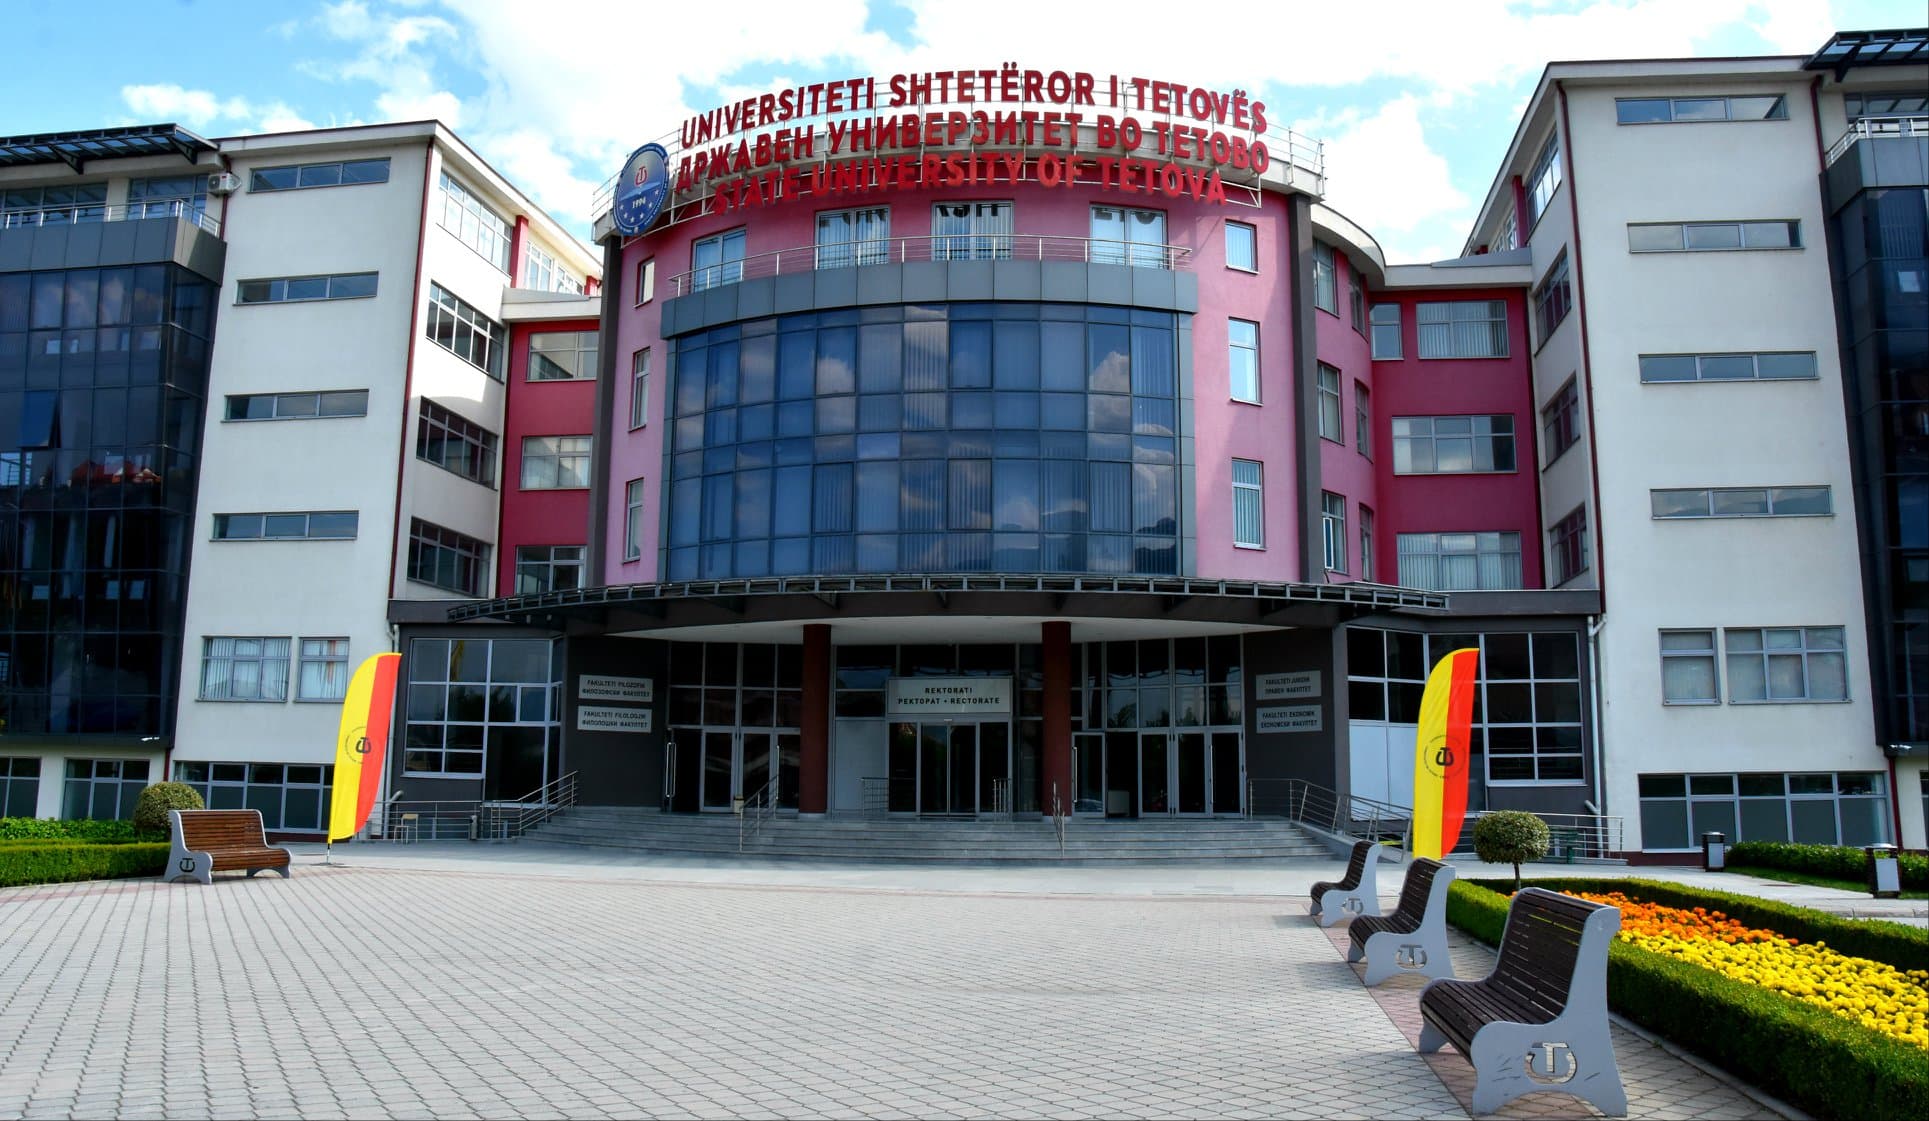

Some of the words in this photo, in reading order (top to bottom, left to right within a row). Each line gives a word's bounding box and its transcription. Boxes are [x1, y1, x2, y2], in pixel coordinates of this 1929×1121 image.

[681, 77, 874, 149] UNIVERSITETI
[889, 62, 1095, 108] SHTETËROR
[1109, 75, 1118, 107] I
[1132, 77, 1267, 134] TETOVËS
[675, 124, 814, 195] ДРЖАВЕН
[828, 111, 1083, 154] УНИВЕРЗИТЕТ
[1097, 115, 1142, 151] ВО
[1152, 121, 1269, 174] ТЕТОВО
[713, 166, 800, 216] STATE
[811, 152, 1023, 197] UNIVERSITY
[1037, 153, 1083, 188] OF
[1096, 156, 1227, 205] TETOVA
[632, 196, 646, 209] 1994
[950, 697, 1001, 705] RECTORATE
